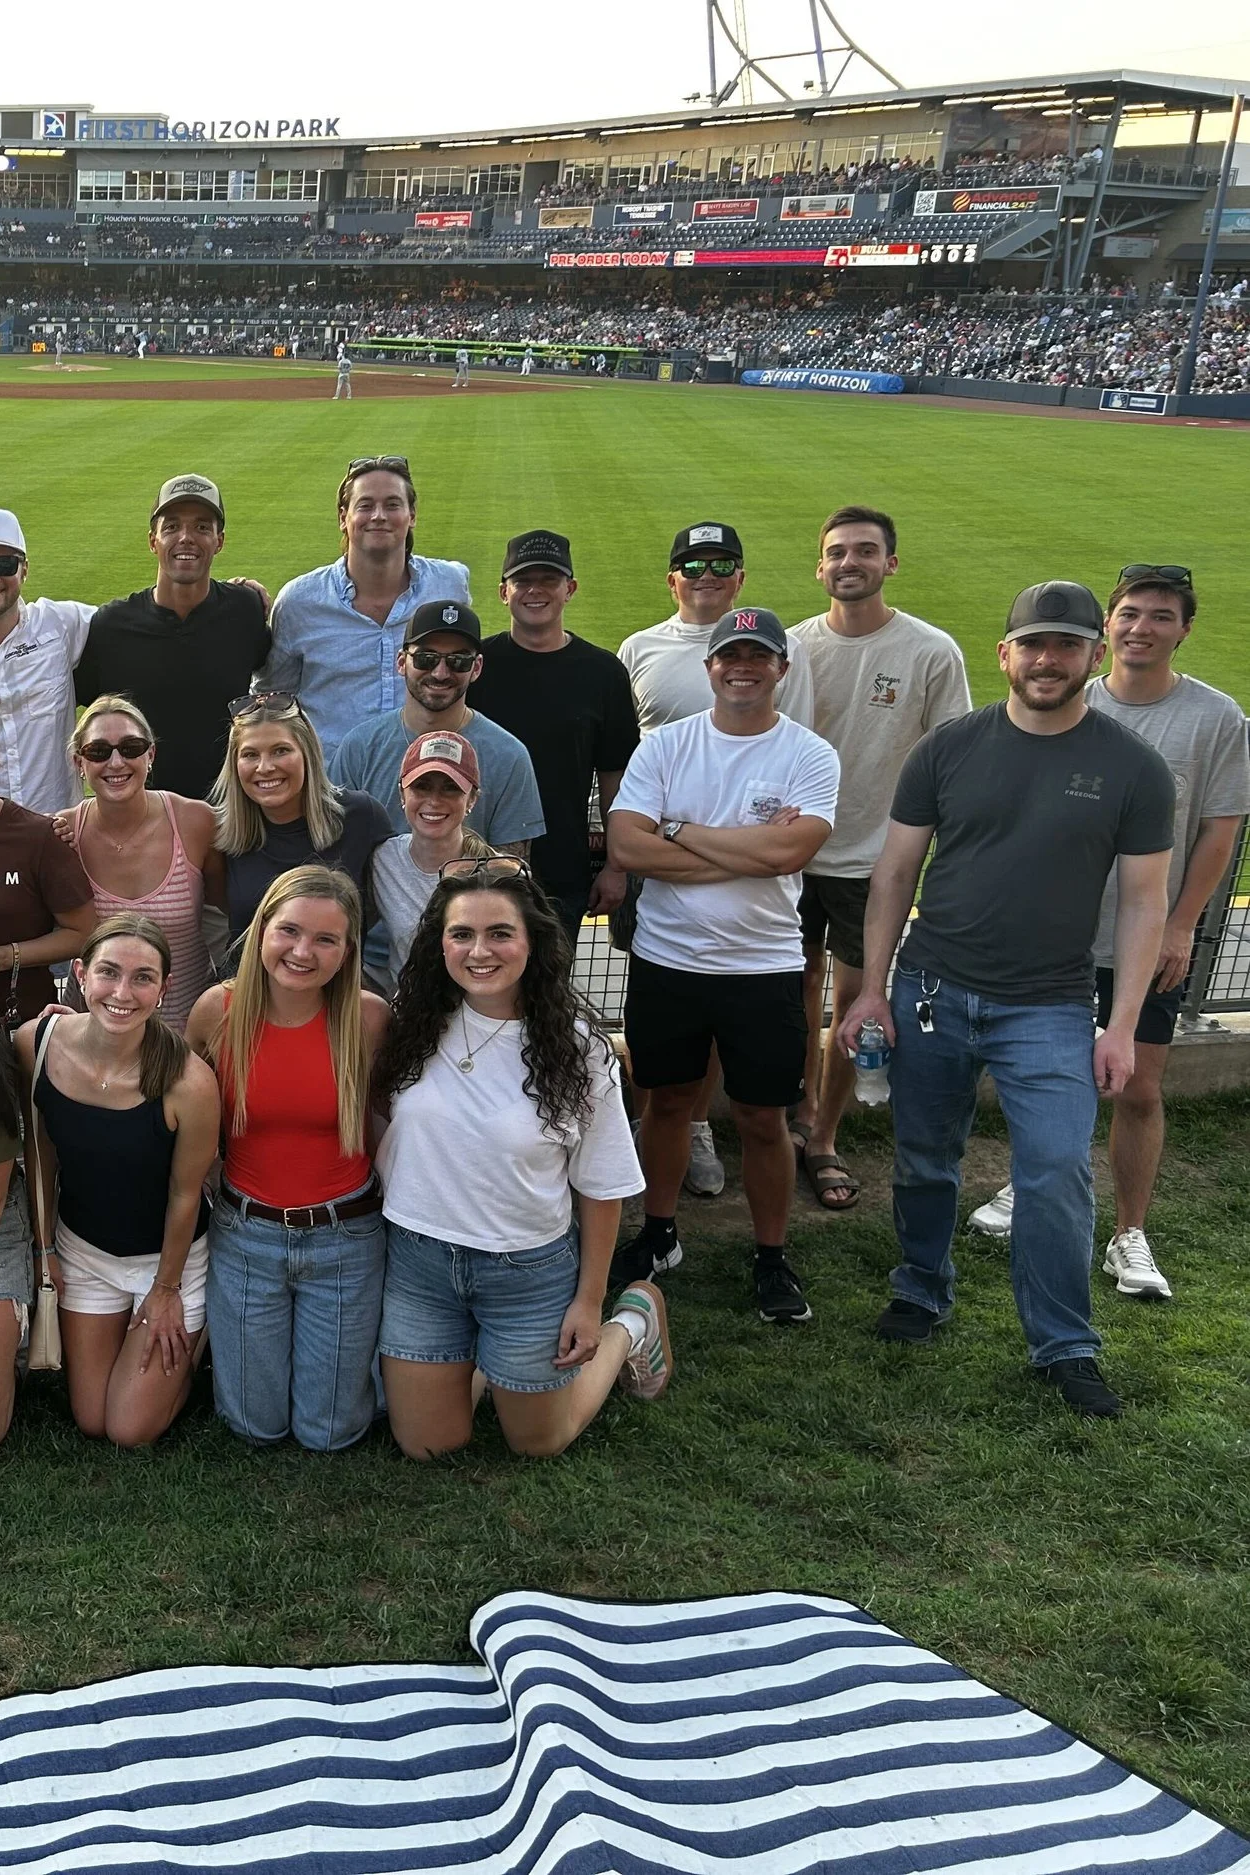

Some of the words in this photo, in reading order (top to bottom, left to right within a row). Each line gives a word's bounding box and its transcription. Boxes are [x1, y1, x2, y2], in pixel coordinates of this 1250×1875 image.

[79, 119, 148, 139] FIRST
[154, 119, 269, 140] HORIZON
[276, 117, 340, 138] PARK
[971, 191, 1038, 202] Advance
[969, 201, 1011, 211] FINANCIAL
[104, 213, 137, 223] Houchens
[139, 213, 171, 223] Insurance
[172, 213, 188, 223] Club
[283, 214, 299, 223] Club
[859, 244, 889, 254] BULLS
[550, 252, 620, 267] PRE-ORDER
[621, 251, 671, 267] TODAY
[773, 370, 810, 382] FIRST
[519, 537, 559, 553] COMPASSION
[734, 612, 758, 631] N
[1064, 789, 1101, 801] FREEDOM
